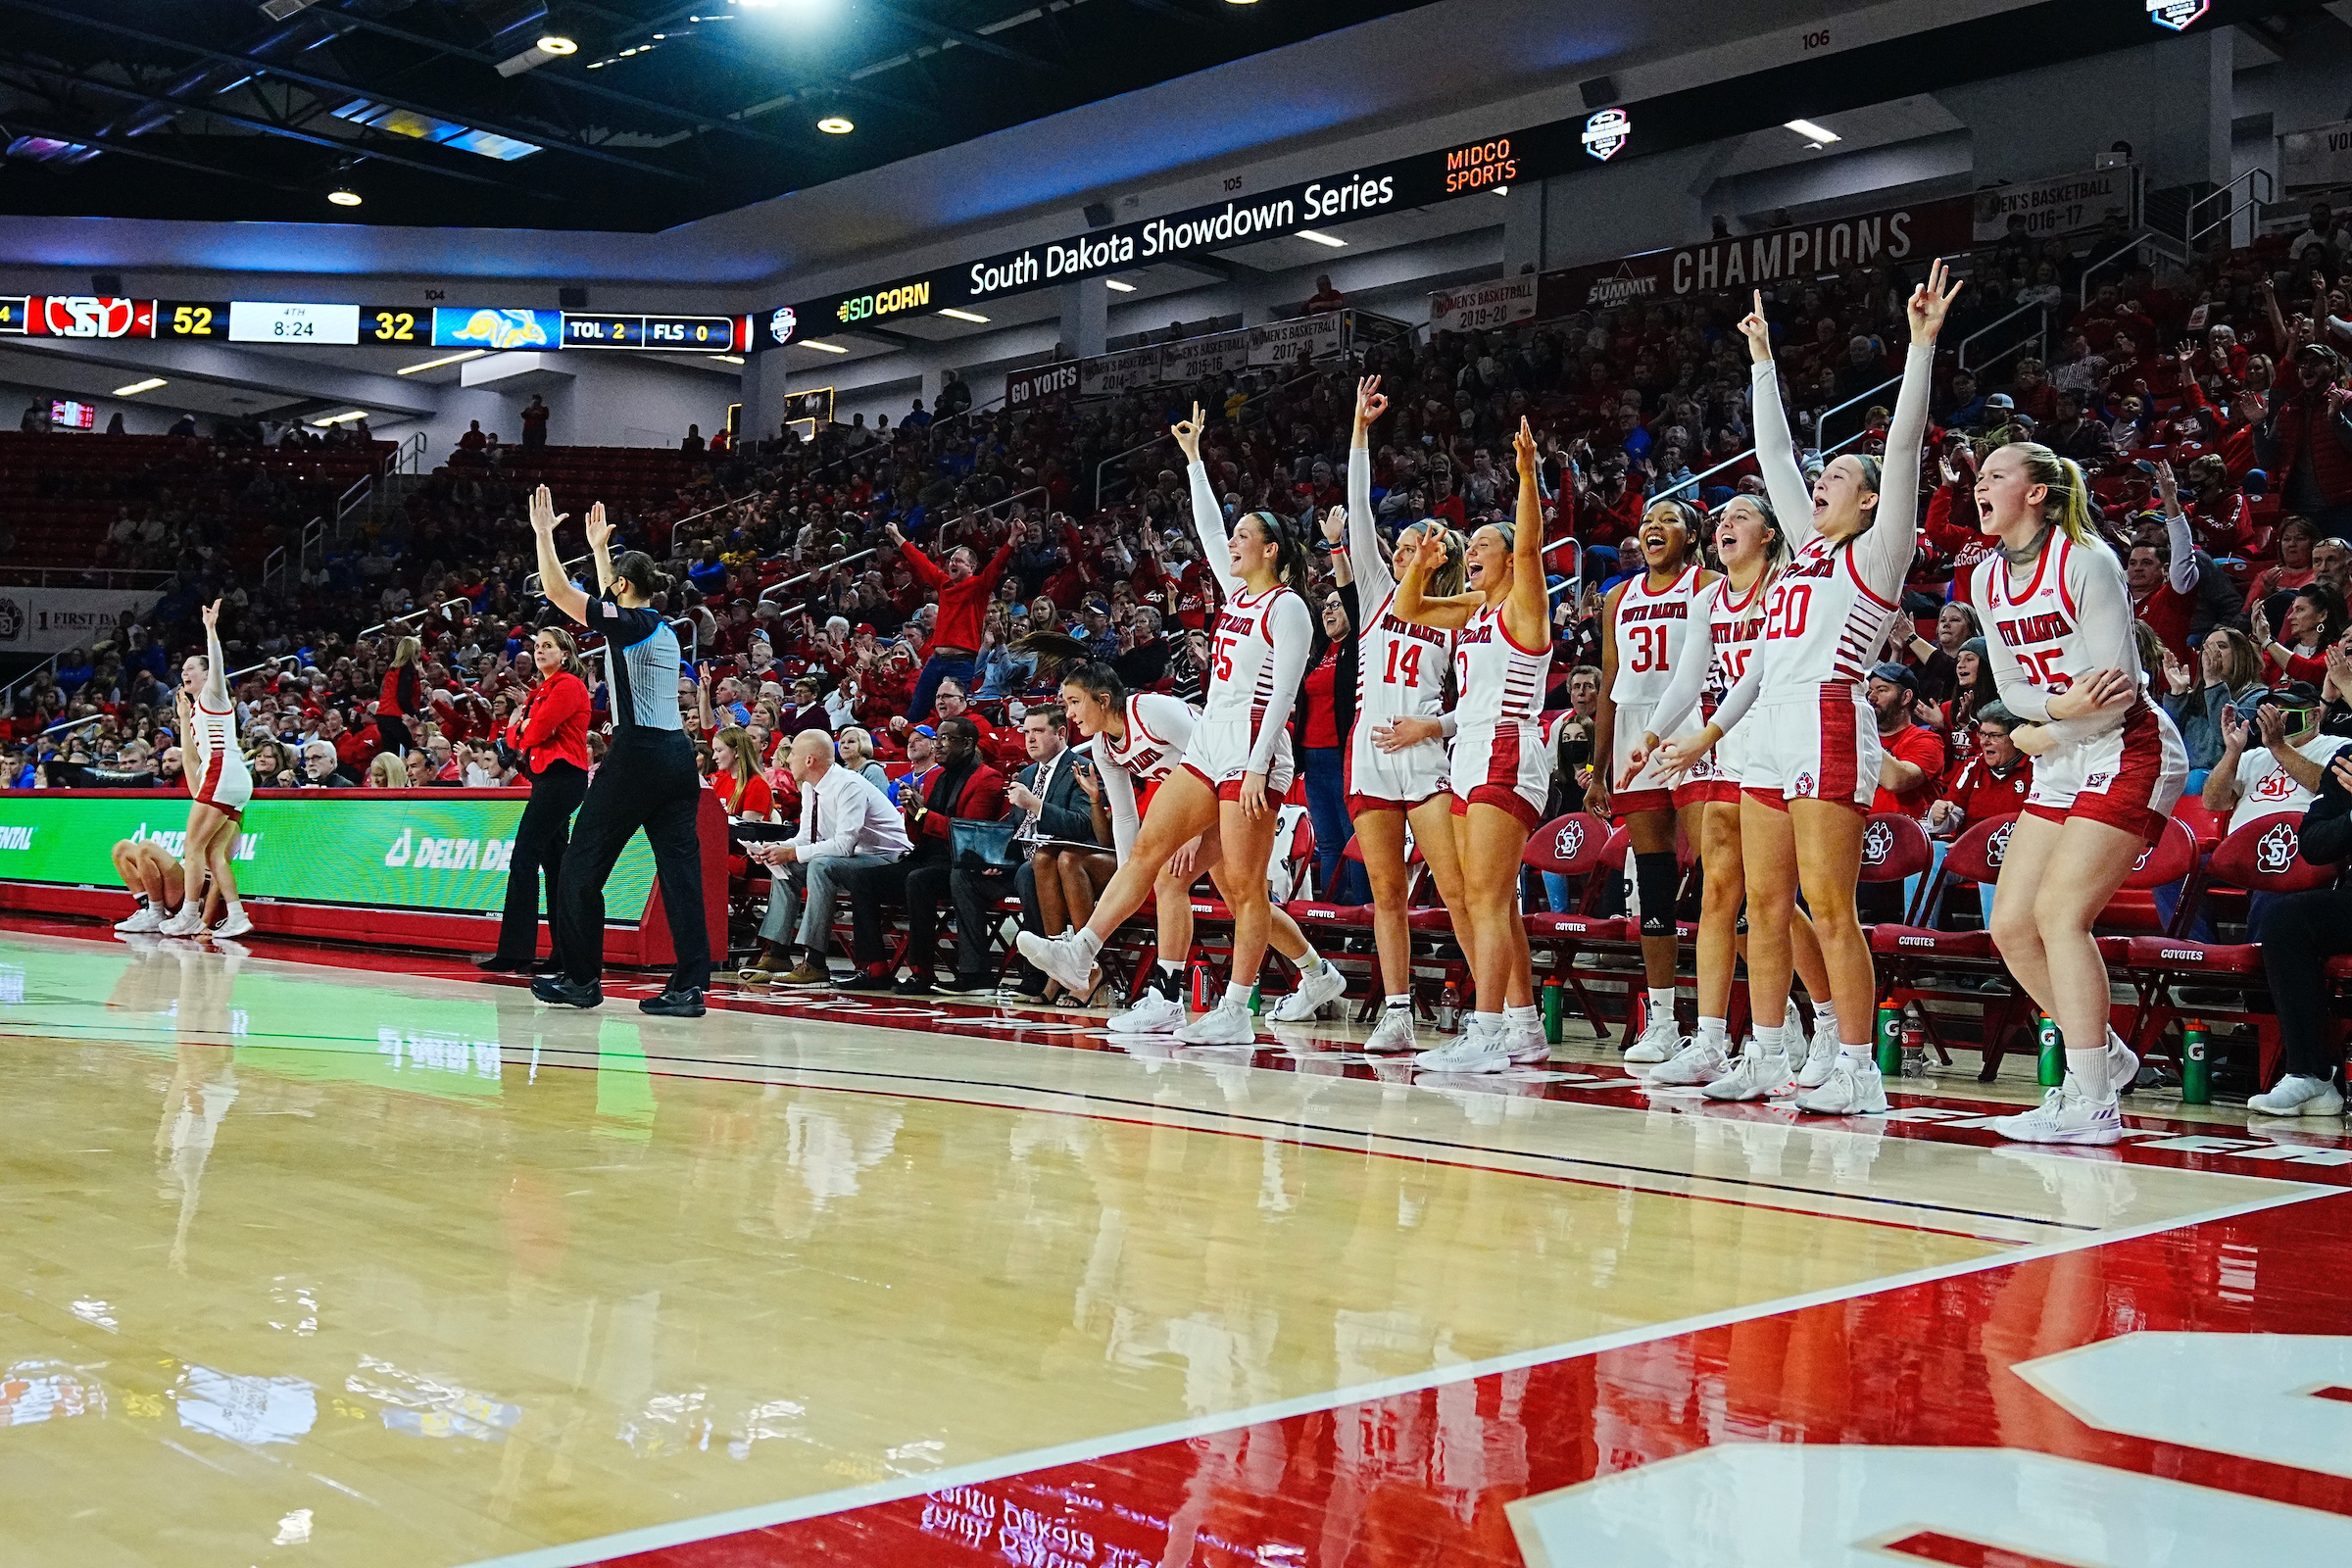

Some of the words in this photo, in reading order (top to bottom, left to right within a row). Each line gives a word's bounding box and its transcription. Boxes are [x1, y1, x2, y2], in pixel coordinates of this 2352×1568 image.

[1801, 29, 1831, 50] 106
[1447, 138, 1510, 171] MIDCO
[1222, 175, 1243, 192] 105
[1446, 160, 1517, 193] SPORTS
[2031, 177, 2114, 208] BASKETBALL
[2028, 204, 2083, 233] 016-17
[969, 249, 1038, 295] South
[1045, 234, 1134, 278] Dakota
[1142, 198, 1295, 257] Showdown
[1303, 173, 1395, 220] Series
[1672, 211, 1912, 296] CHAMPIONS
[424, 289, 446, 301] 104
[1478, 283, 1533, 307] BASKETBALL
[1586, 273, 1658, 305] SUMMIT
[850, 295, 874, 321] SD
[875, 281, 930, 315] CORN
[173, 307, 213, 335] 52
[283, 308, 306, 318] 4TH
[1460, 305, 1508, 328] 2019-20
[273, 321, 315, 338] 8:24
[374, 311, 415, 341] 32
[570, 321, 605, 339] TOL
[612, 322, 626, 341] 2
[654, 323, 685, 341] FLS
[696, 325, 709, 342] 0
[1288, 318, 1337, 340] BASKETBALL
[1186, 356, 1223, 377] 2015-16
[1011, 382, 1030, 405] GO
[1033, 365, 1077, 400] YOTES
[54, 612, 95, 625] FIRST
[1648, 602, 1689, 620] DAKOTA
[1766, 584, 1813, 640] 20
[2018, 611, 2074, 645] DAKOTA
[1629, 624, 1670, 673] 31
[1383, 639, 1423, 688] 14
[413, 837, 480, 870] DELTA
[1306, 908, 1336, 919] COYOTES
[1555, 922, 1587, 932] COYOTES
[1898, 935, 1936, 948] COYOTES
[2160, 948, 2204, 961] COYOTES
[1884, 1019, 1900, 1037] G
[2040, 1029, 2057, 1047] G
[2187, 1042, 2206, 1061] G
